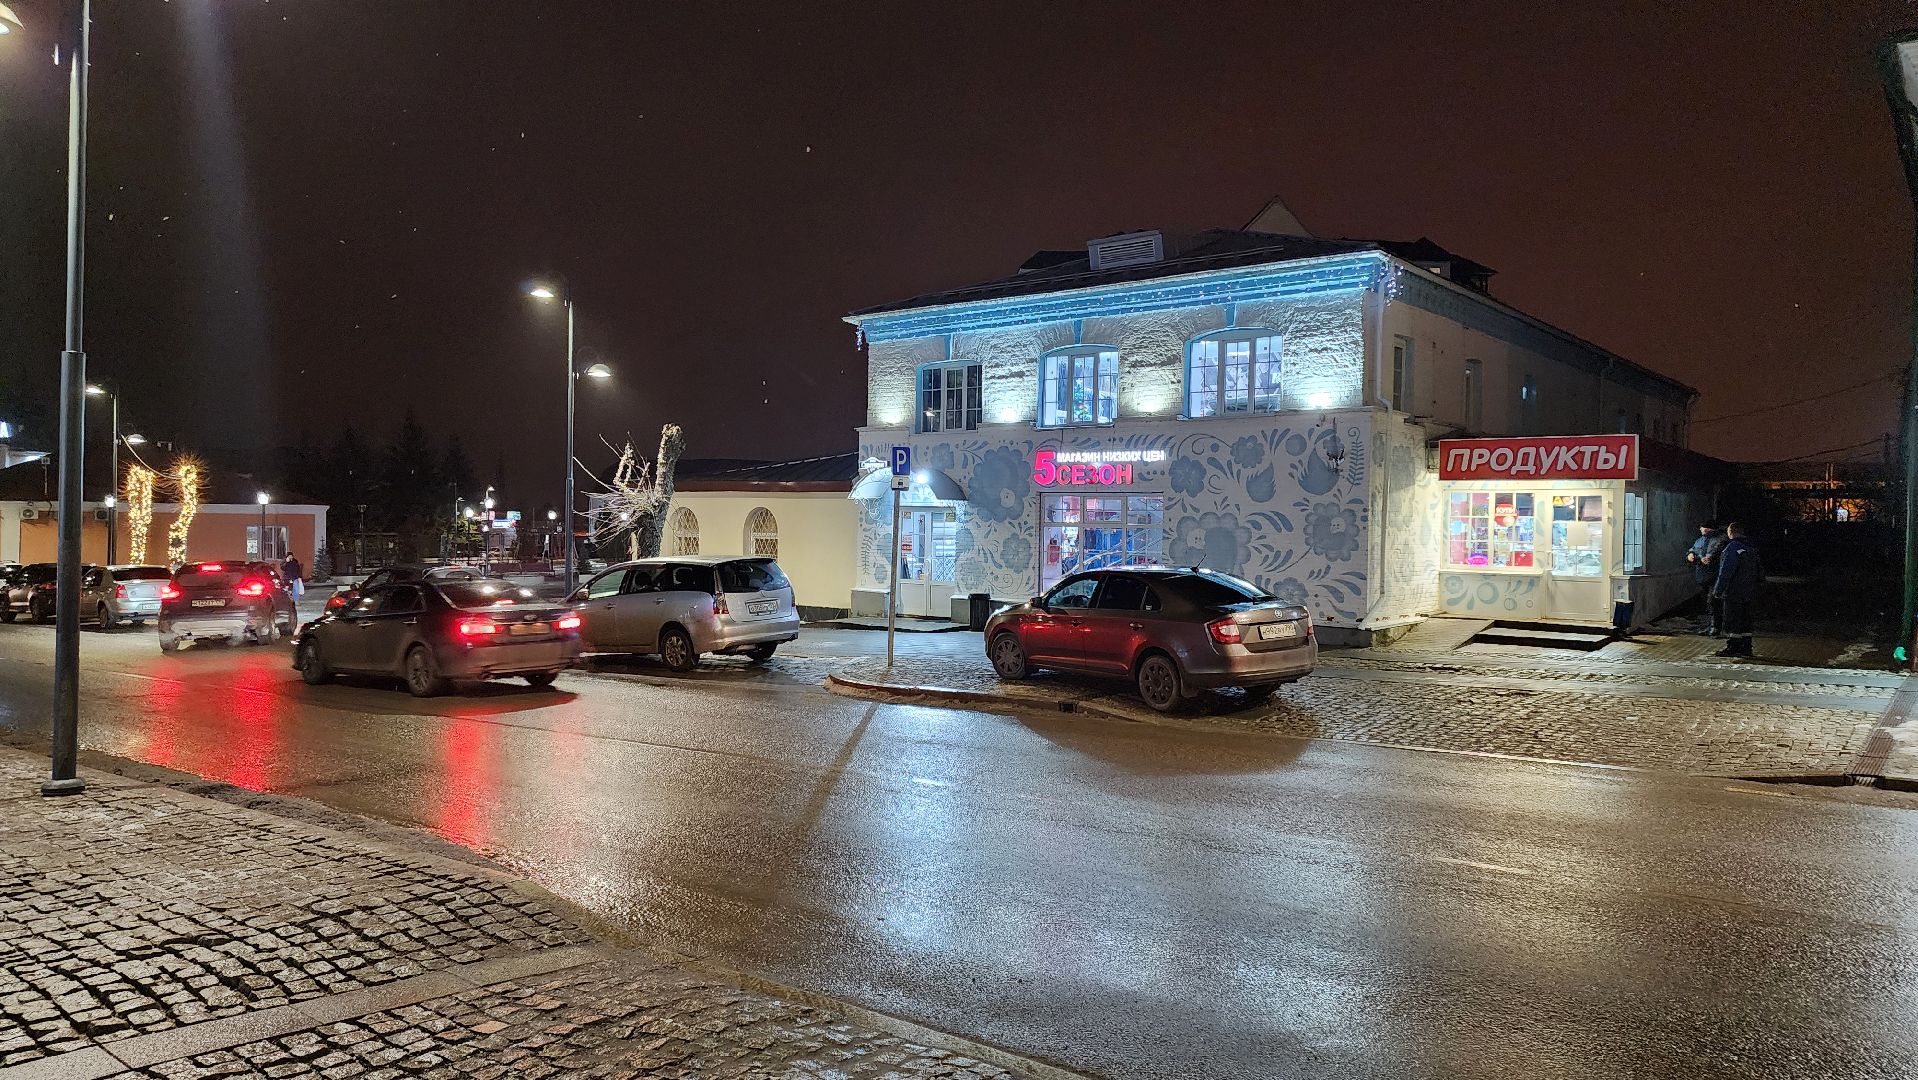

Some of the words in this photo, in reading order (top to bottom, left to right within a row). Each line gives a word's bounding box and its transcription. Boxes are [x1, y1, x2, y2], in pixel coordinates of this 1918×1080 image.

[896, 449, 907, 473] P
[1033, 449, 1056, 485] 5
[1056, 463, 1133, 486] СЕЗОН
[1057, 452, 1101, 463] МАГАЗИН
[1102, 451, 1141, 462] НИЗКИХ
[1143, 450, 1166, 462] ЦЕН
[1447, 445, 1628, 475] ПРОДУКТЫ
